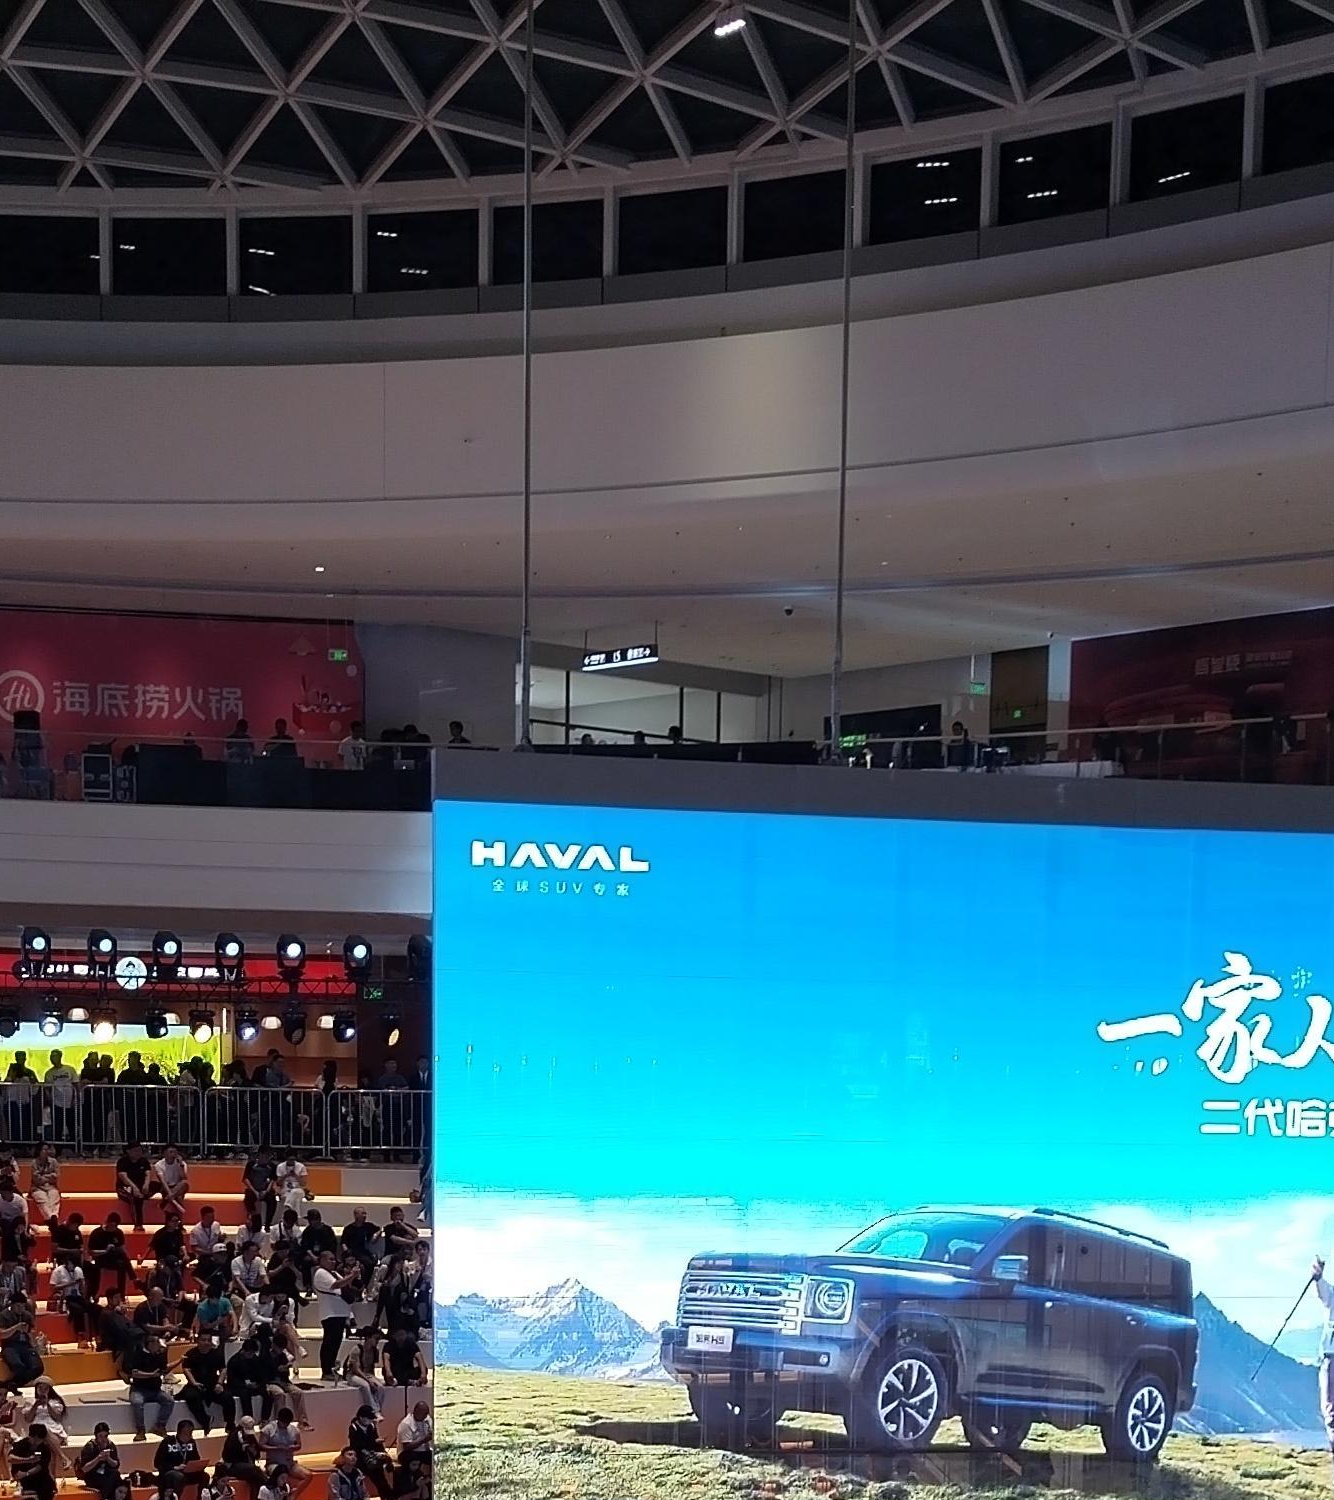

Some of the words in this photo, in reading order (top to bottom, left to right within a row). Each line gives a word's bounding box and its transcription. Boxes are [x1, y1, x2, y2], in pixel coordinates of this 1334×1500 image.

[52, 680, 244, 722] 海底捞火锅
[471, 840, 650, 872] HAVAL
[492, 878, 630, 897] 全球SUV专家
